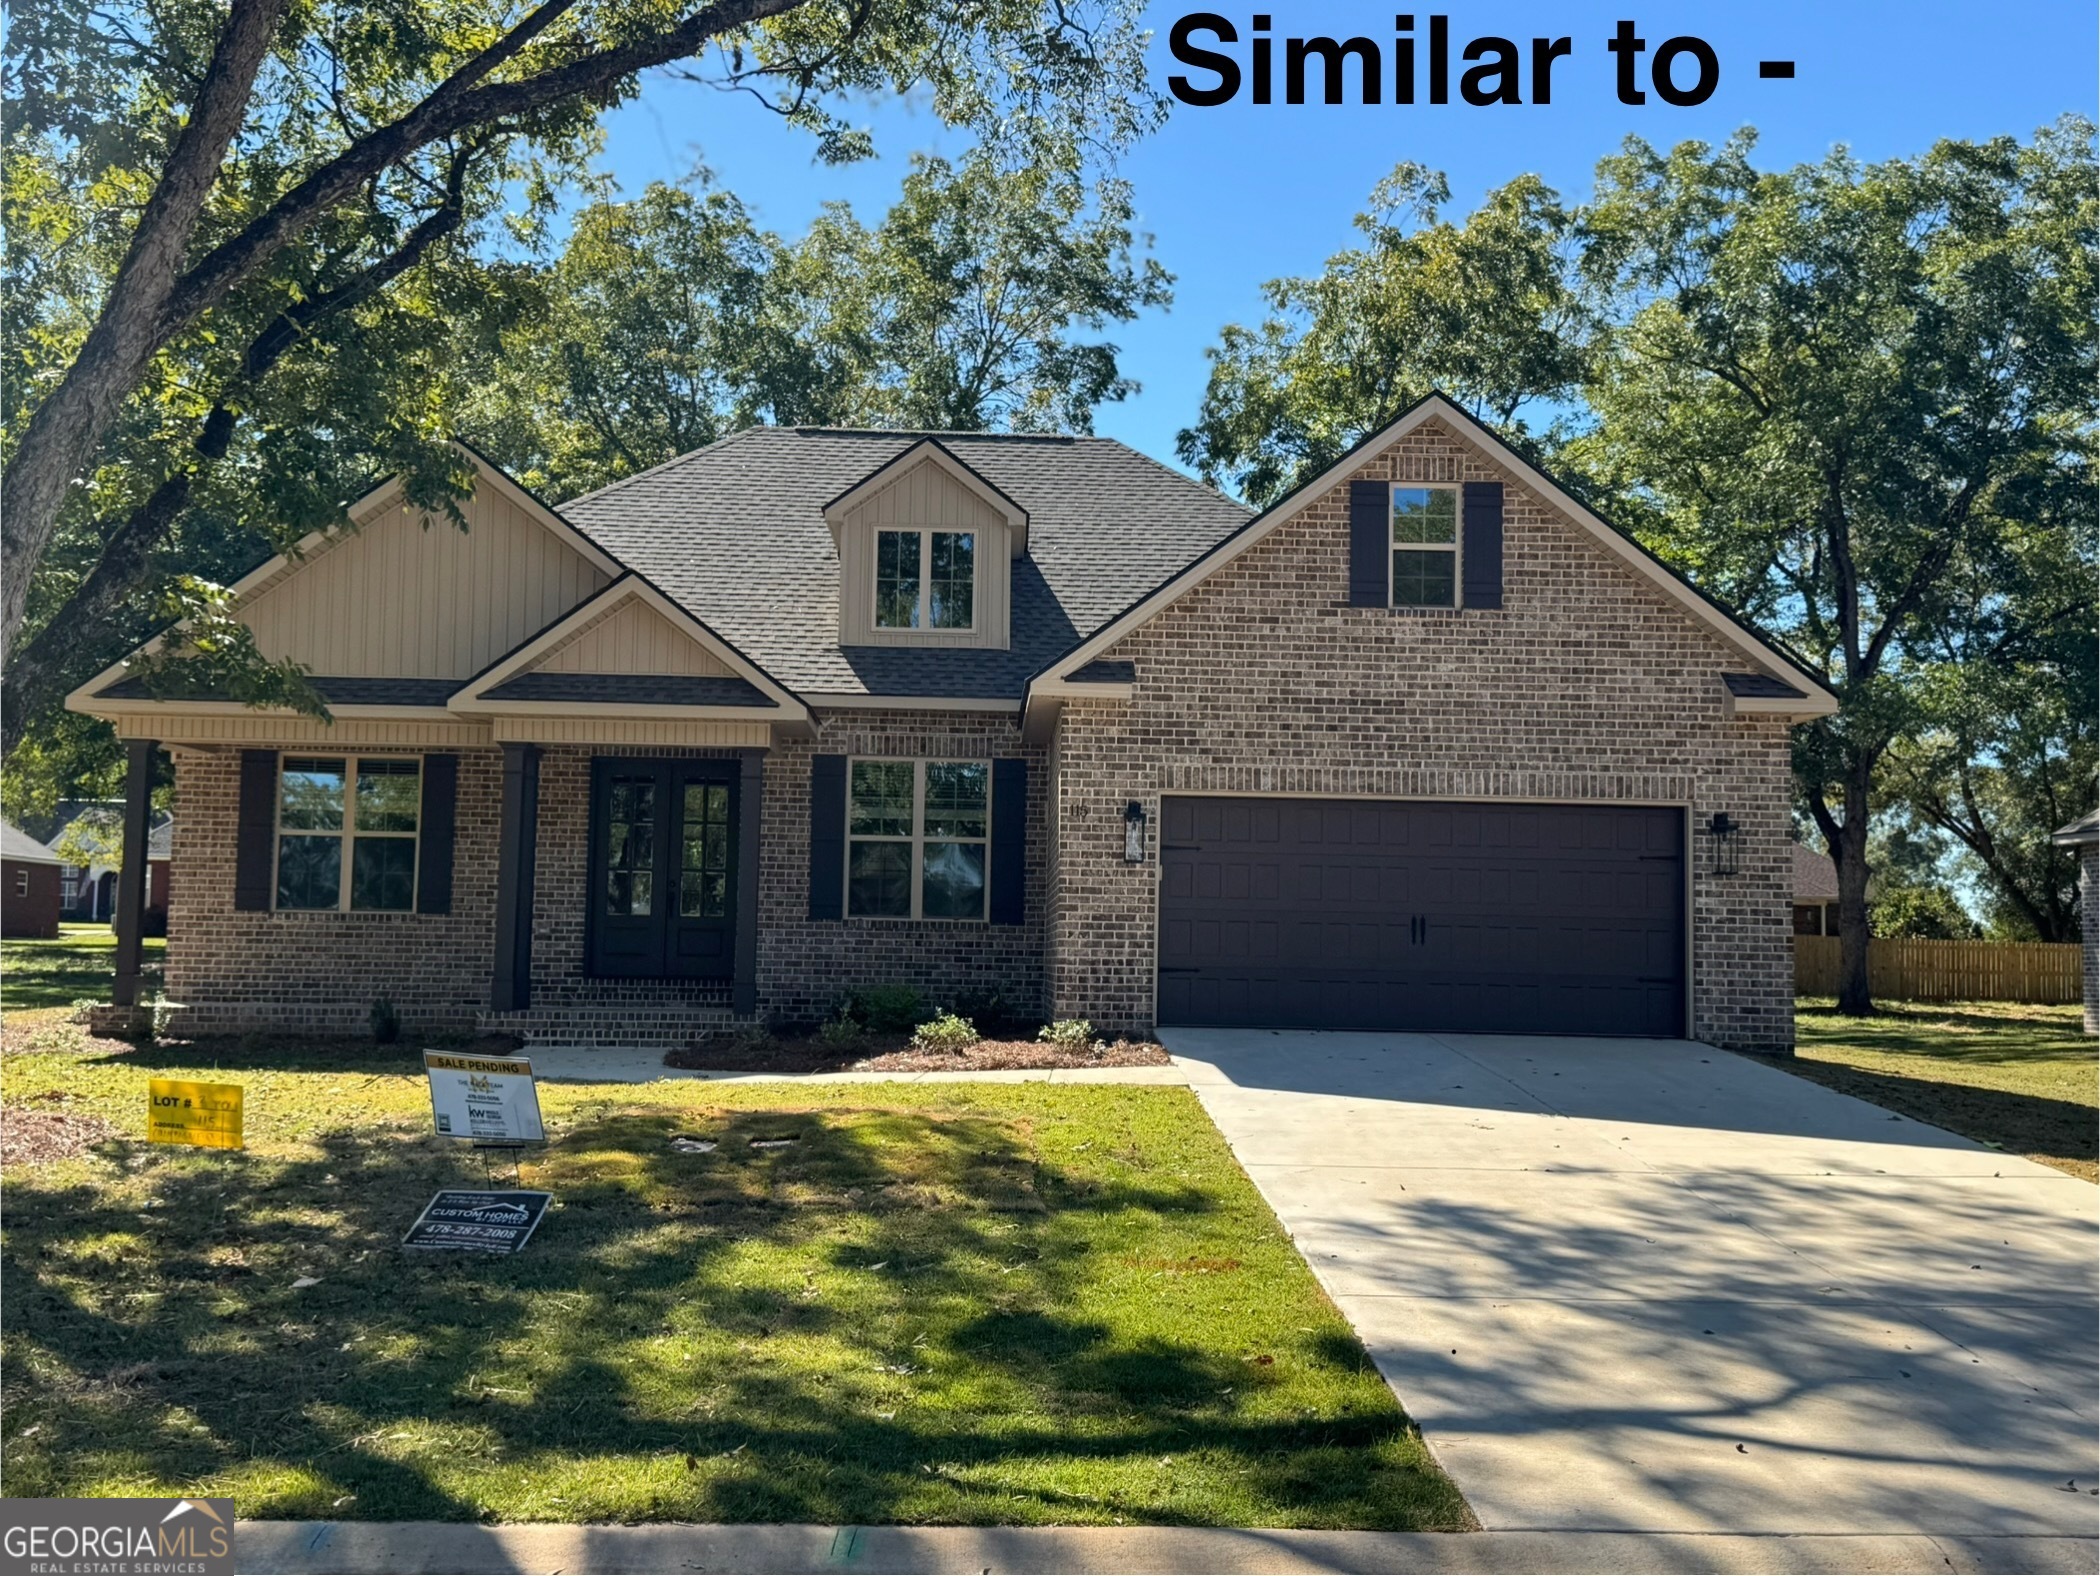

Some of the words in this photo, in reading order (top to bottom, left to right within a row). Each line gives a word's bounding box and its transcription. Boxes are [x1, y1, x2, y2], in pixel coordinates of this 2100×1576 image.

[1070, 804, 1088, 818] 115
[437, 1057, 465, 1069] SALE
[468, 1060, 519, 1074] PENDING
[153, 1095, 180, 1108] LOT
[183, 1098, 192, 1108] #
[468, 1104, 485, 1119] kw
[431, 1208, 484, 1218] CUSTOM
[483, 1211, 529, 1221] HOMES
[425, 1224, 518, 1239] 478-287-2008
